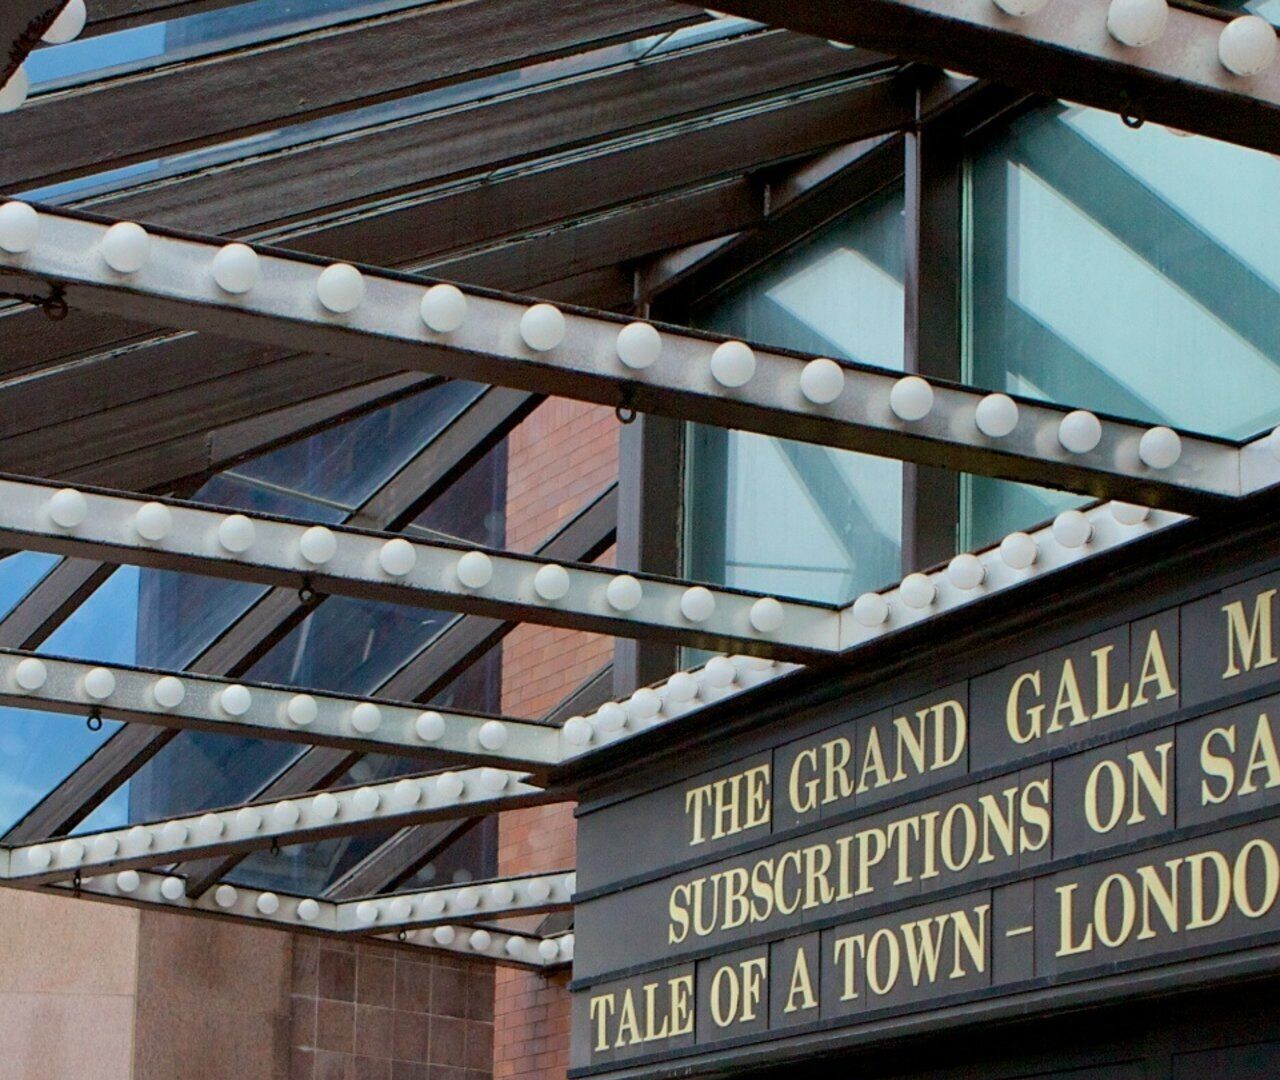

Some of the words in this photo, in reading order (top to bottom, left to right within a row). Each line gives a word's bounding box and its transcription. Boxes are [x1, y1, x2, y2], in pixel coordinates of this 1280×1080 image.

[686, 763, 770, 846] THE
[788, 700, 966, 814] GRAND
[1005, 629, 1176, 745] GALA
[668, 778, 1050, 945] SUBSCRIPTIONS
[1083, 741, 1173, 834] ON
[589, 974, 693, 1053] TALE
[709, 956, 766, 1028] OF
[784, 947, 817, 1014] A
[834, 904, 990, 1001] TOWN
